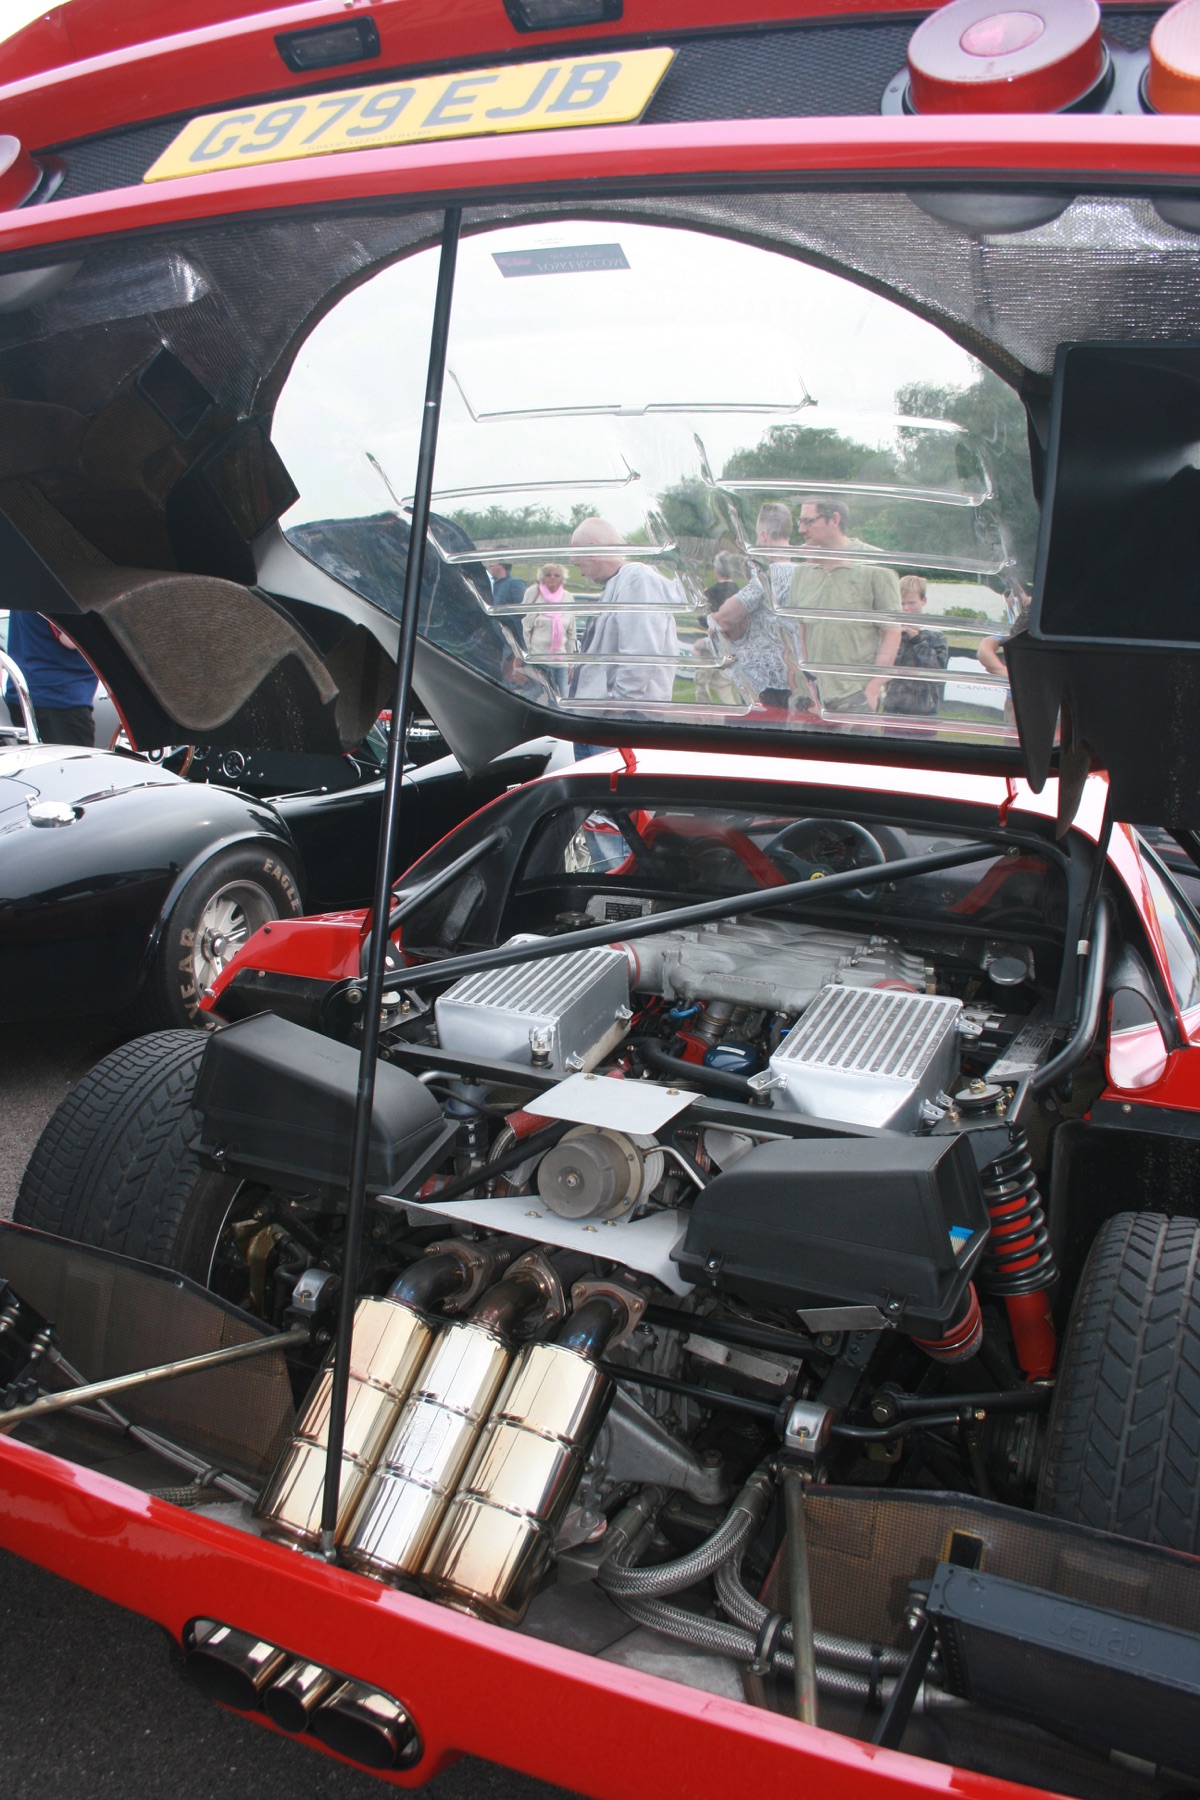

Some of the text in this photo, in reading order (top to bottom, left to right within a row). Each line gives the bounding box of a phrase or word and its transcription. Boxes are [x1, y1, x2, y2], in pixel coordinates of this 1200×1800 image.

[187, 60, 623, 163] G979 EJB
[262, 857, 301, 912] EAGLE
[1046, 1605, 1143, 1658] Setrab
